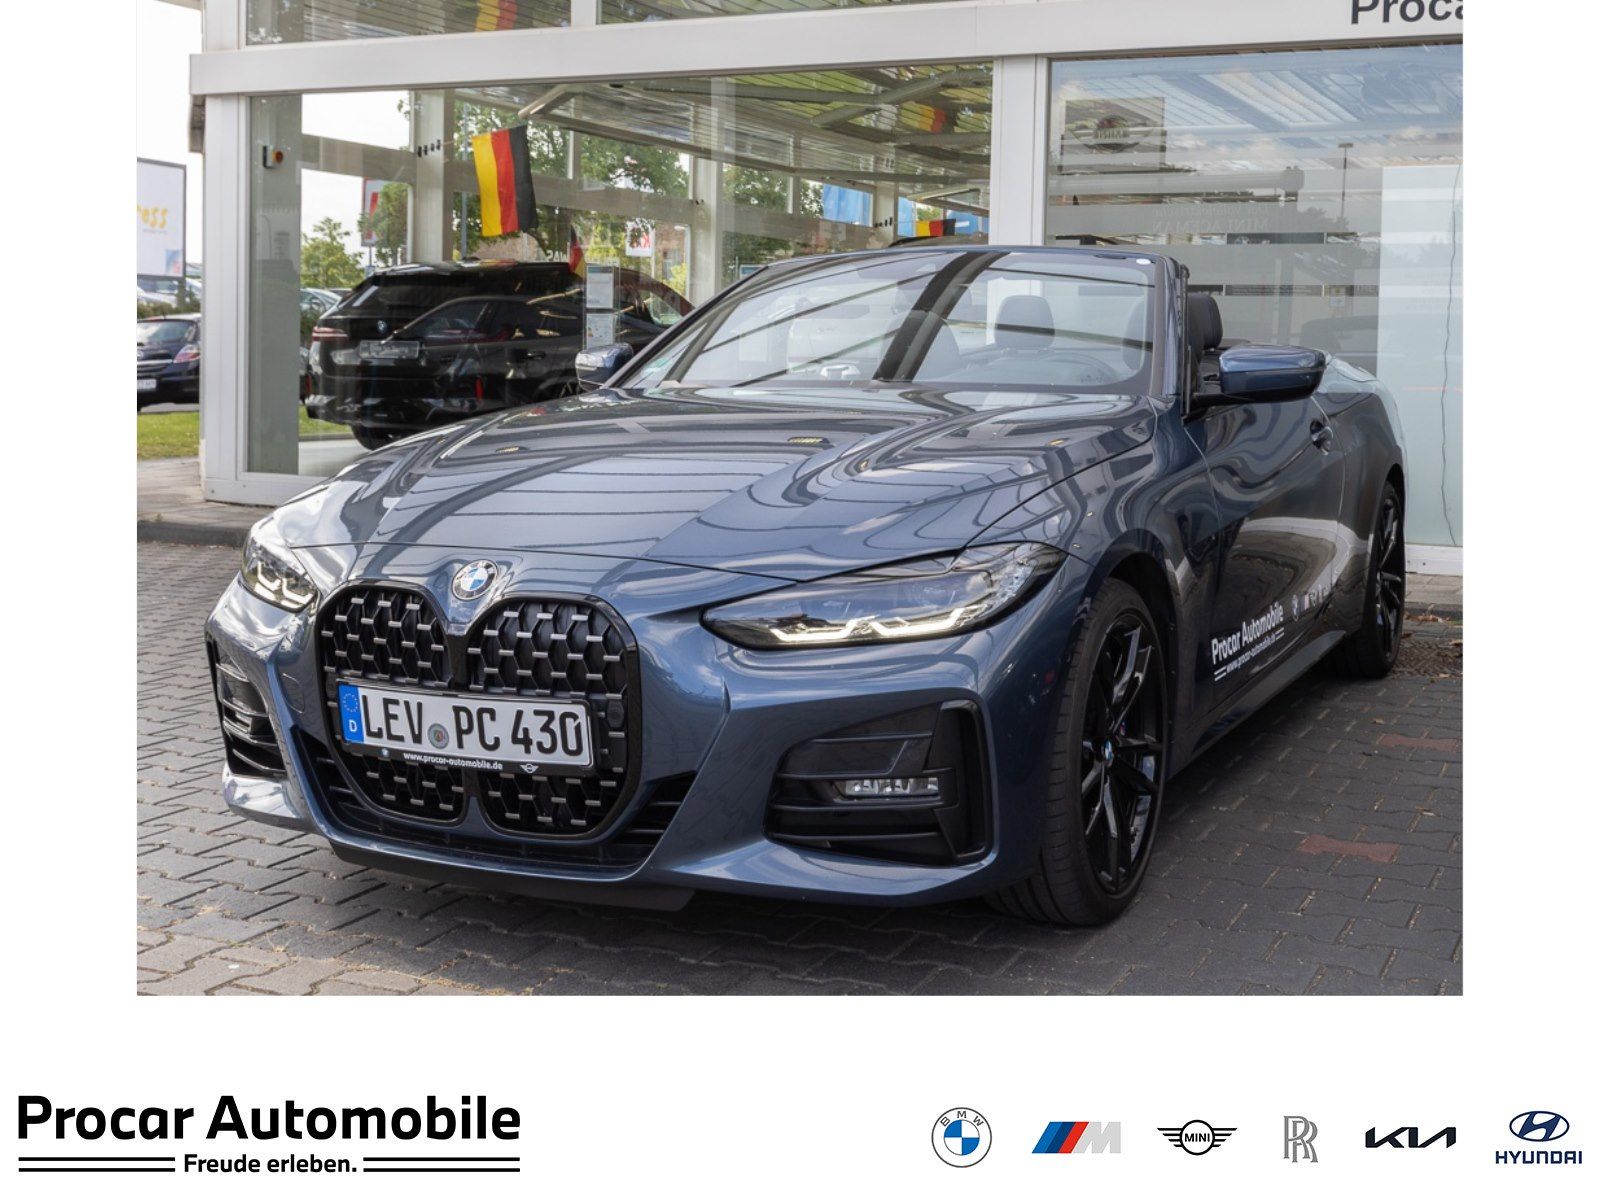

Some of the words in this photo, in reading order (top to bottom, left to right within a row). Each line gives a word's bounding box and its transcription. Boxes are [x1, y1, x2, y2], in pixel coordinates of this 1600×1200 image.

[1211, 637, 1241, 665] Procar
[1241, 601, 1284, 647] Automobile
[349, 719, 358, 733] D
[361, 694, 423, 745] LEV
[452, 705, 501, 752] PC
[510, 709, 584, 757] 430
[403, 752, 504, 770] www.procar-automobile.de
